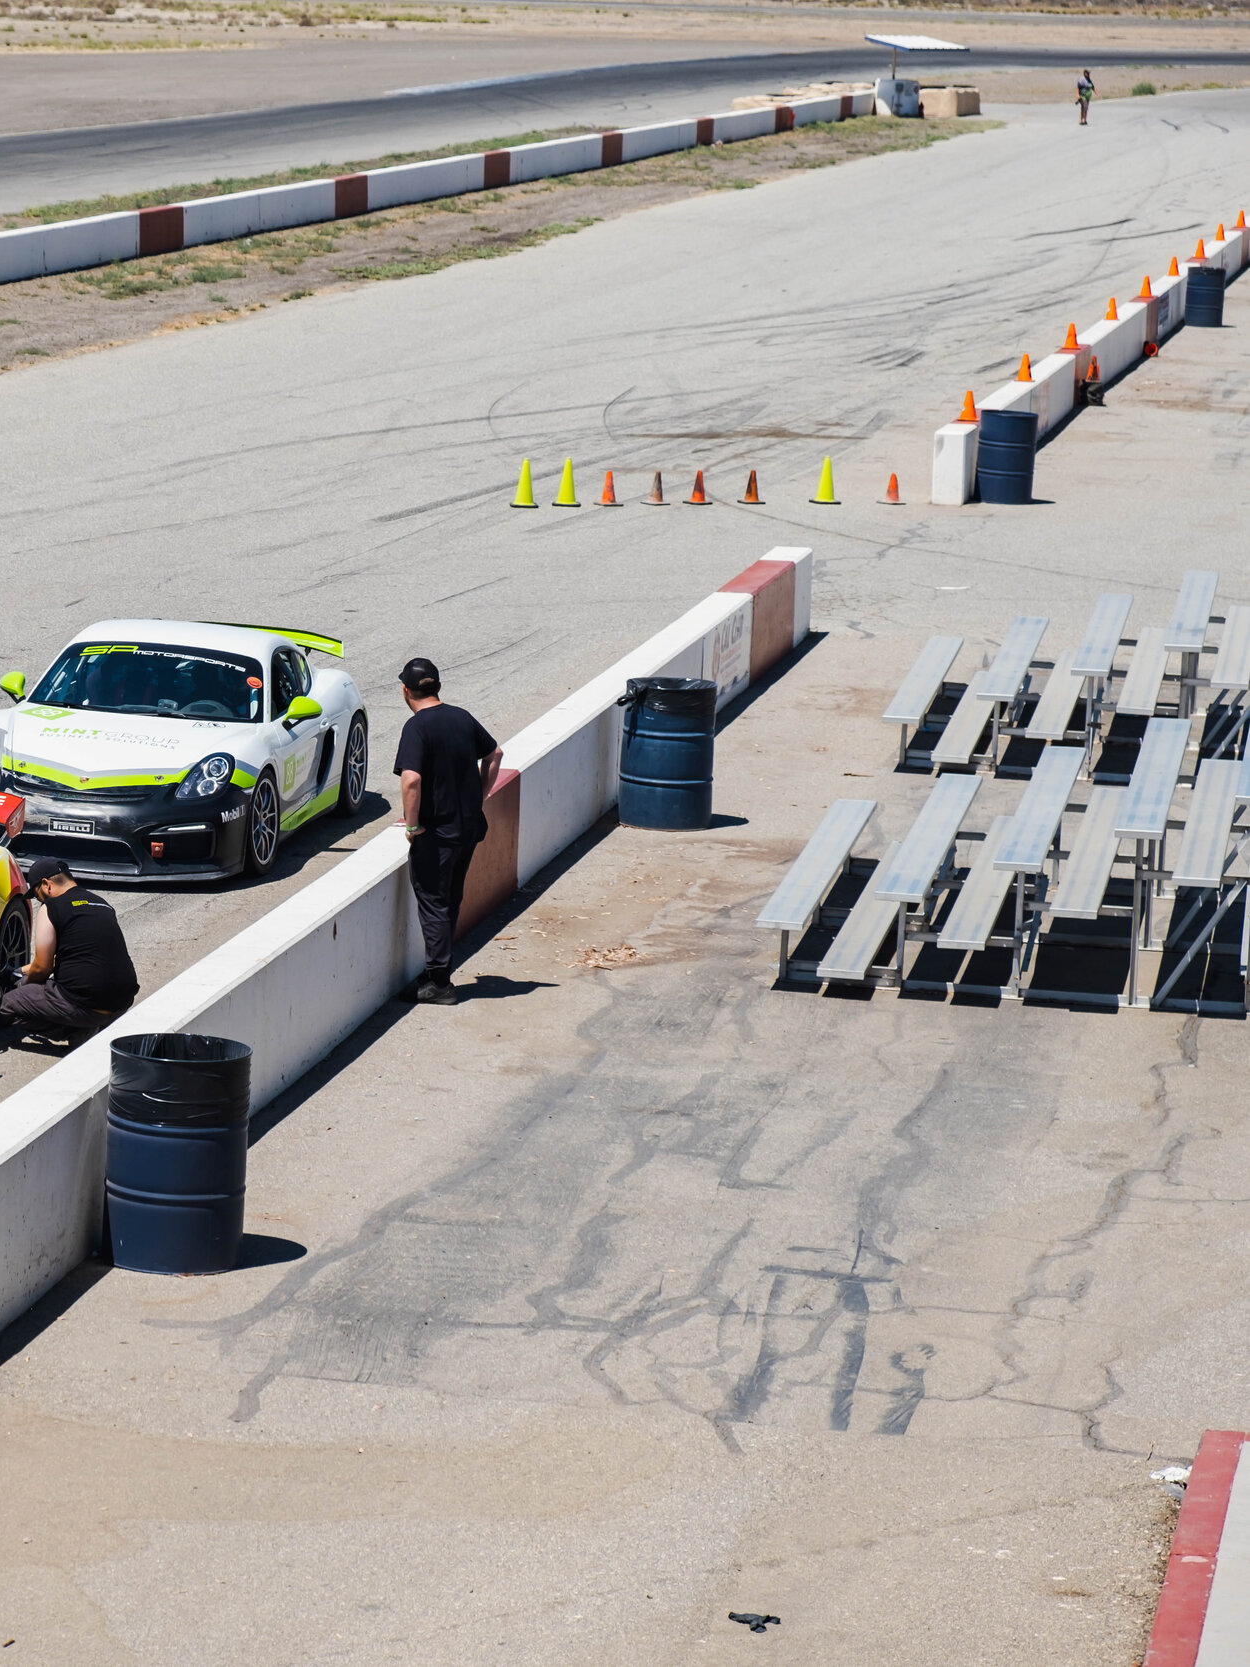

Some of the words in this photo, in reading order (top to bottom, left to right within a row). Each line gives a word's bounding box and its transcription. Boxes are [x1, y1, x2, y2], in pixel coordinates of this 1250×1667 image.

[79, 645, 139, 656] SP
[133, 650, 246, 672] MOTORSPORTS
[105, 737, 175, 749] SOLUTIONS
[221, 806, 240, 823] Mobil
[52, 820, 91, 832] PIRELLI
